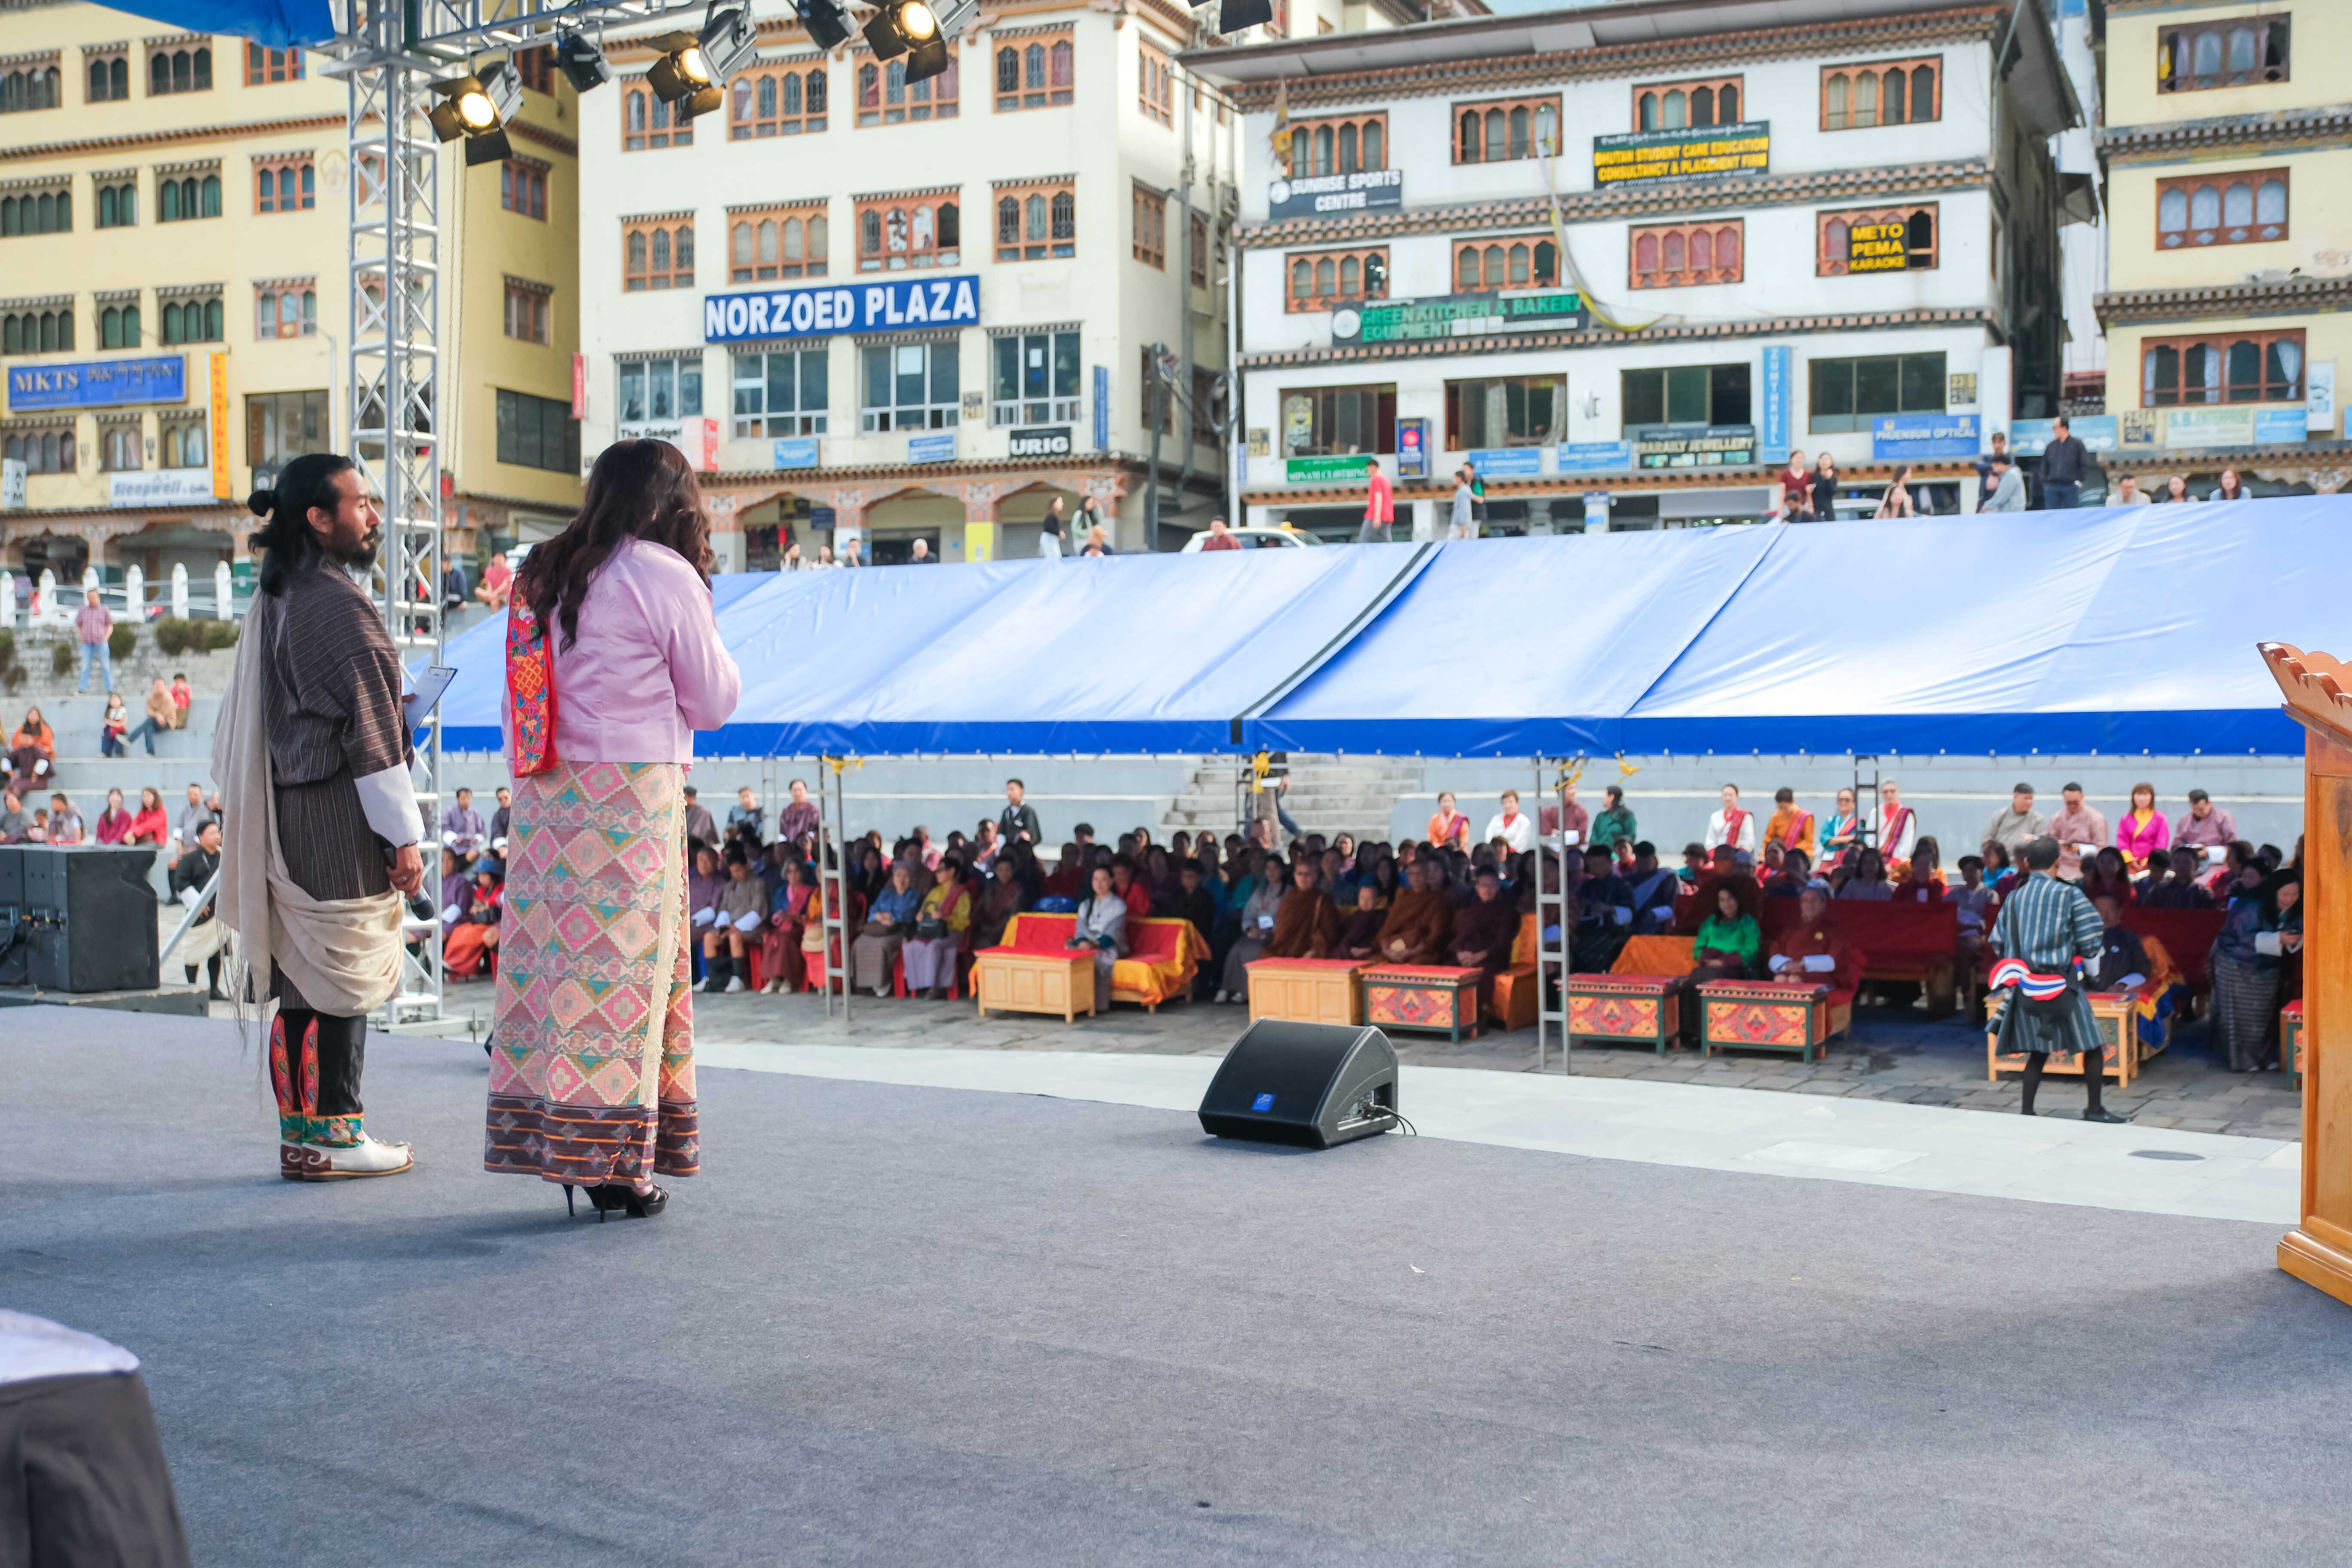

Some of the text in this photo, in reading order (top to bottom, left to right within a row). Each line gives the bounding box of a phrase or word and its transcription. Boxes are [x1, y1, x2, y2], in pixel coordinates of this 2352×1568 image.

[1635, 144, 1681, 162] STUDENT
[1682, 142, 1709, 158] CARE
[1710, 136, 1769, 154] EDUCATION
[1741, 152, 1767, 167] FIRM
[1291, 170, 1400, 195] SUNRISE SPORTS
[1315, 191, 1366, 212] CENTRE
[1851, 223, 1904, 241] METO
[1852, 239, 1904, 257] PEMA
[1850, 255, 1906, 271] KARAOKE
[705, 280, 977, 338] NORZOED PLAZA
[1360, 307, 1415, 325] GREEN
[1416, 300, 1489, 324] KITCHEN
[1495, 300, 1508, 315] &
[1362, 320, 1452, 342] EQUIPMENT
[16, 371, 79, 392] MKTS
[622, 429, 640, 438] The
[1933, 428, 1977, 439] OPTICAL
[1011, 436, 1069, 456] URIG
[1689, 437, 1753, 452] JEWELLERY
